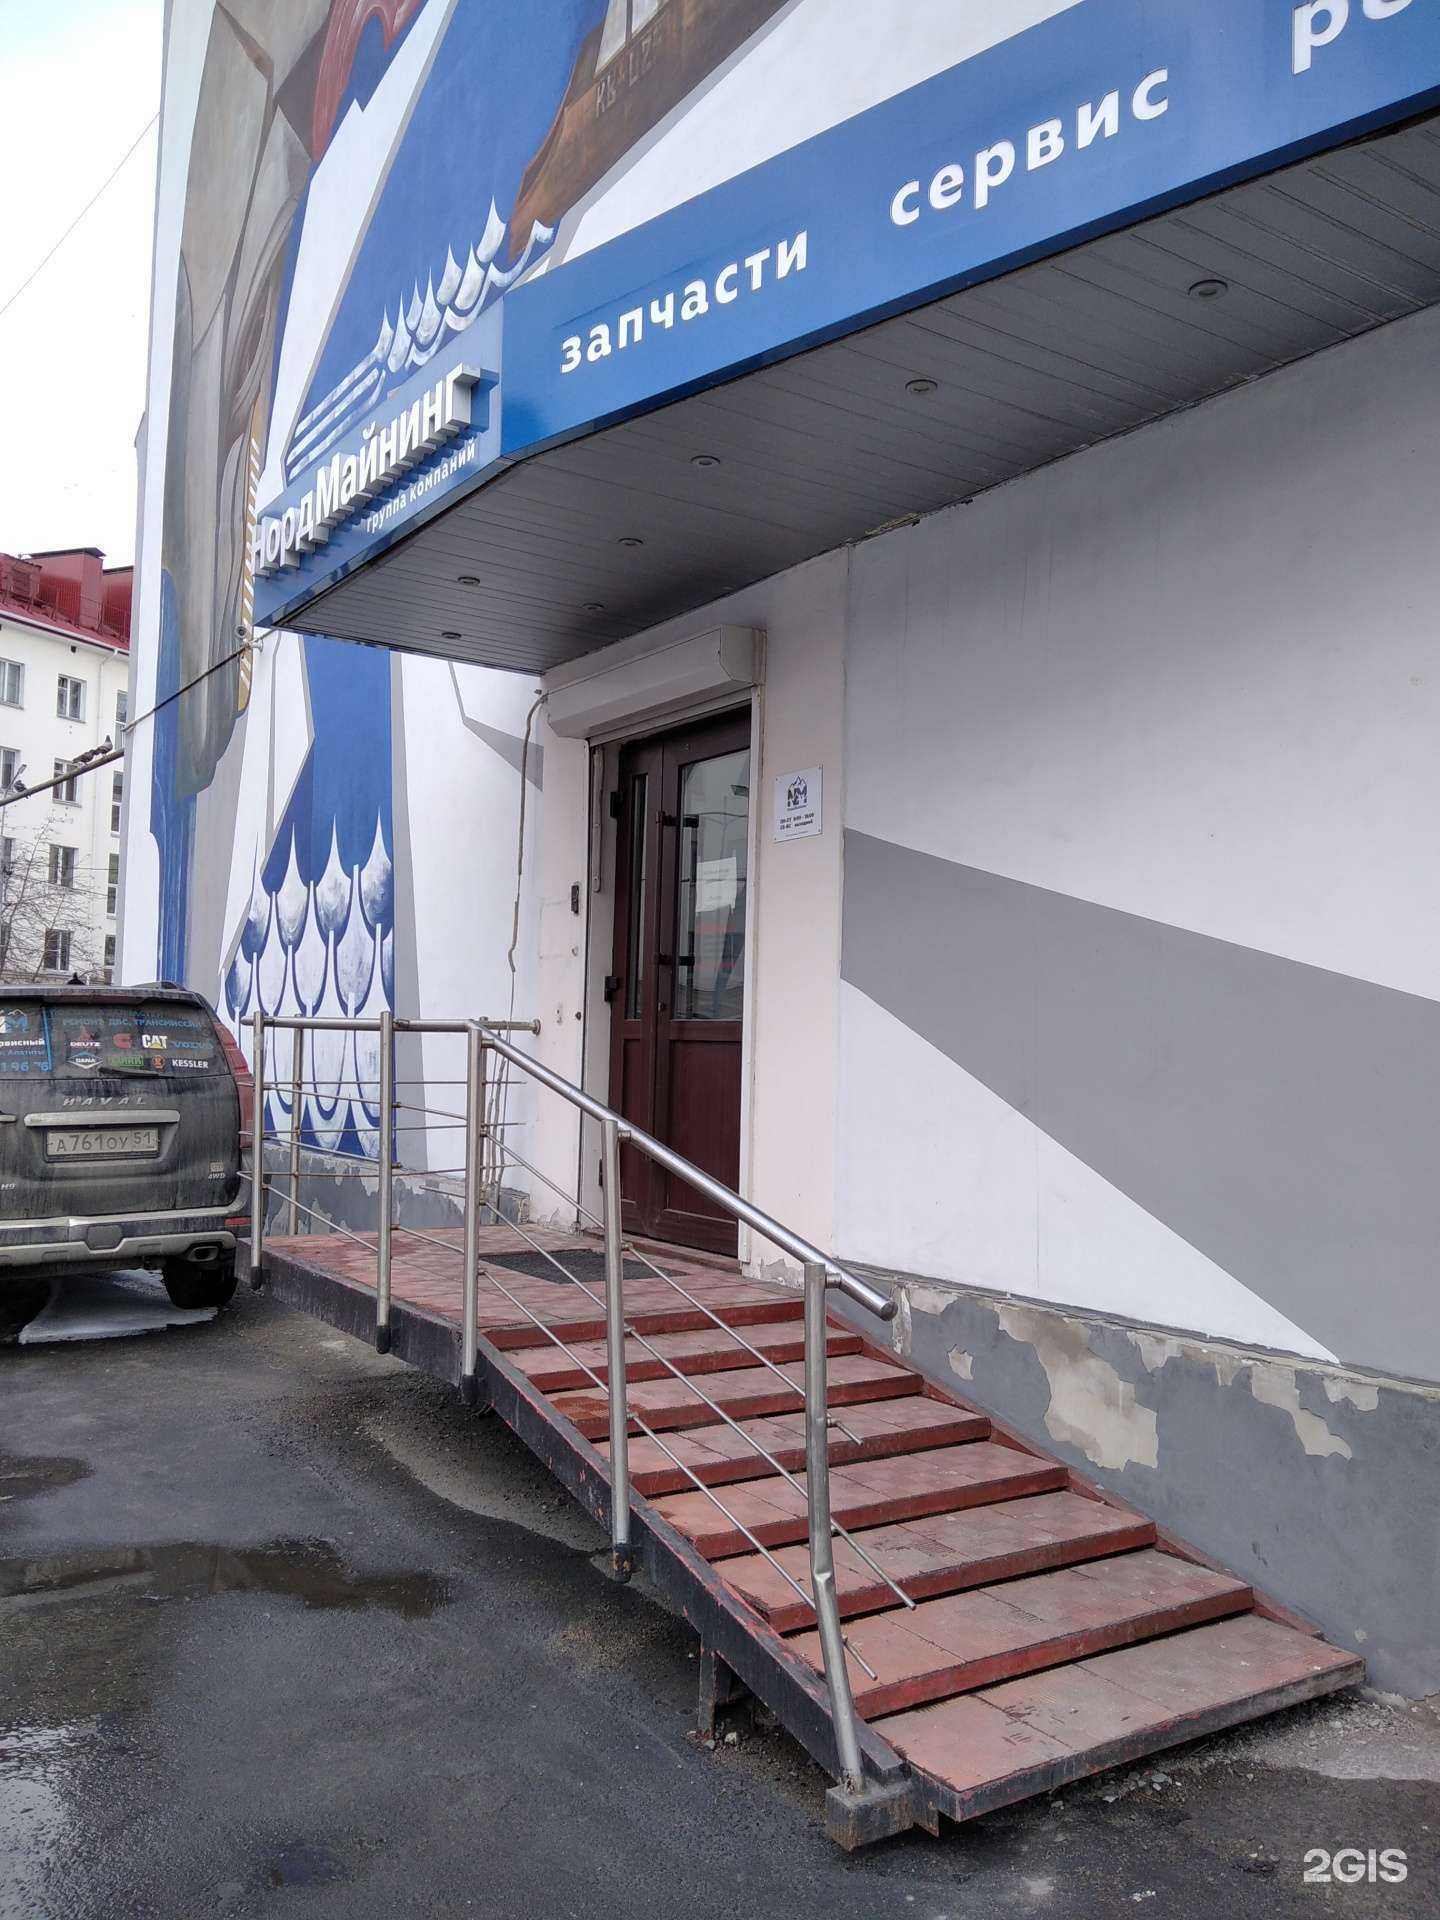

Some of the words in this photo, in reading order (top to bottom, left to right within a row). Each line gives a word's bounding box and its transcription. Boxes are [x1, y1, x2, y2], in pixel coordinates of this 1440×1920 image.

[560, 231, 808, 374] запчасти
[890, 66, 1169, 226] сервис
[366, 496, 407, 534] группа
[410, 437, 476, 502] компаний
[142, 1034, 168, 1049] CAT
[172, 1059, 209, 1069] KESSLER
[63, 1096, 146, 1106] HAVAL
[56, 1134, 128, 1152] А761ОУ
[134, 1131, 151, 1145] 51
